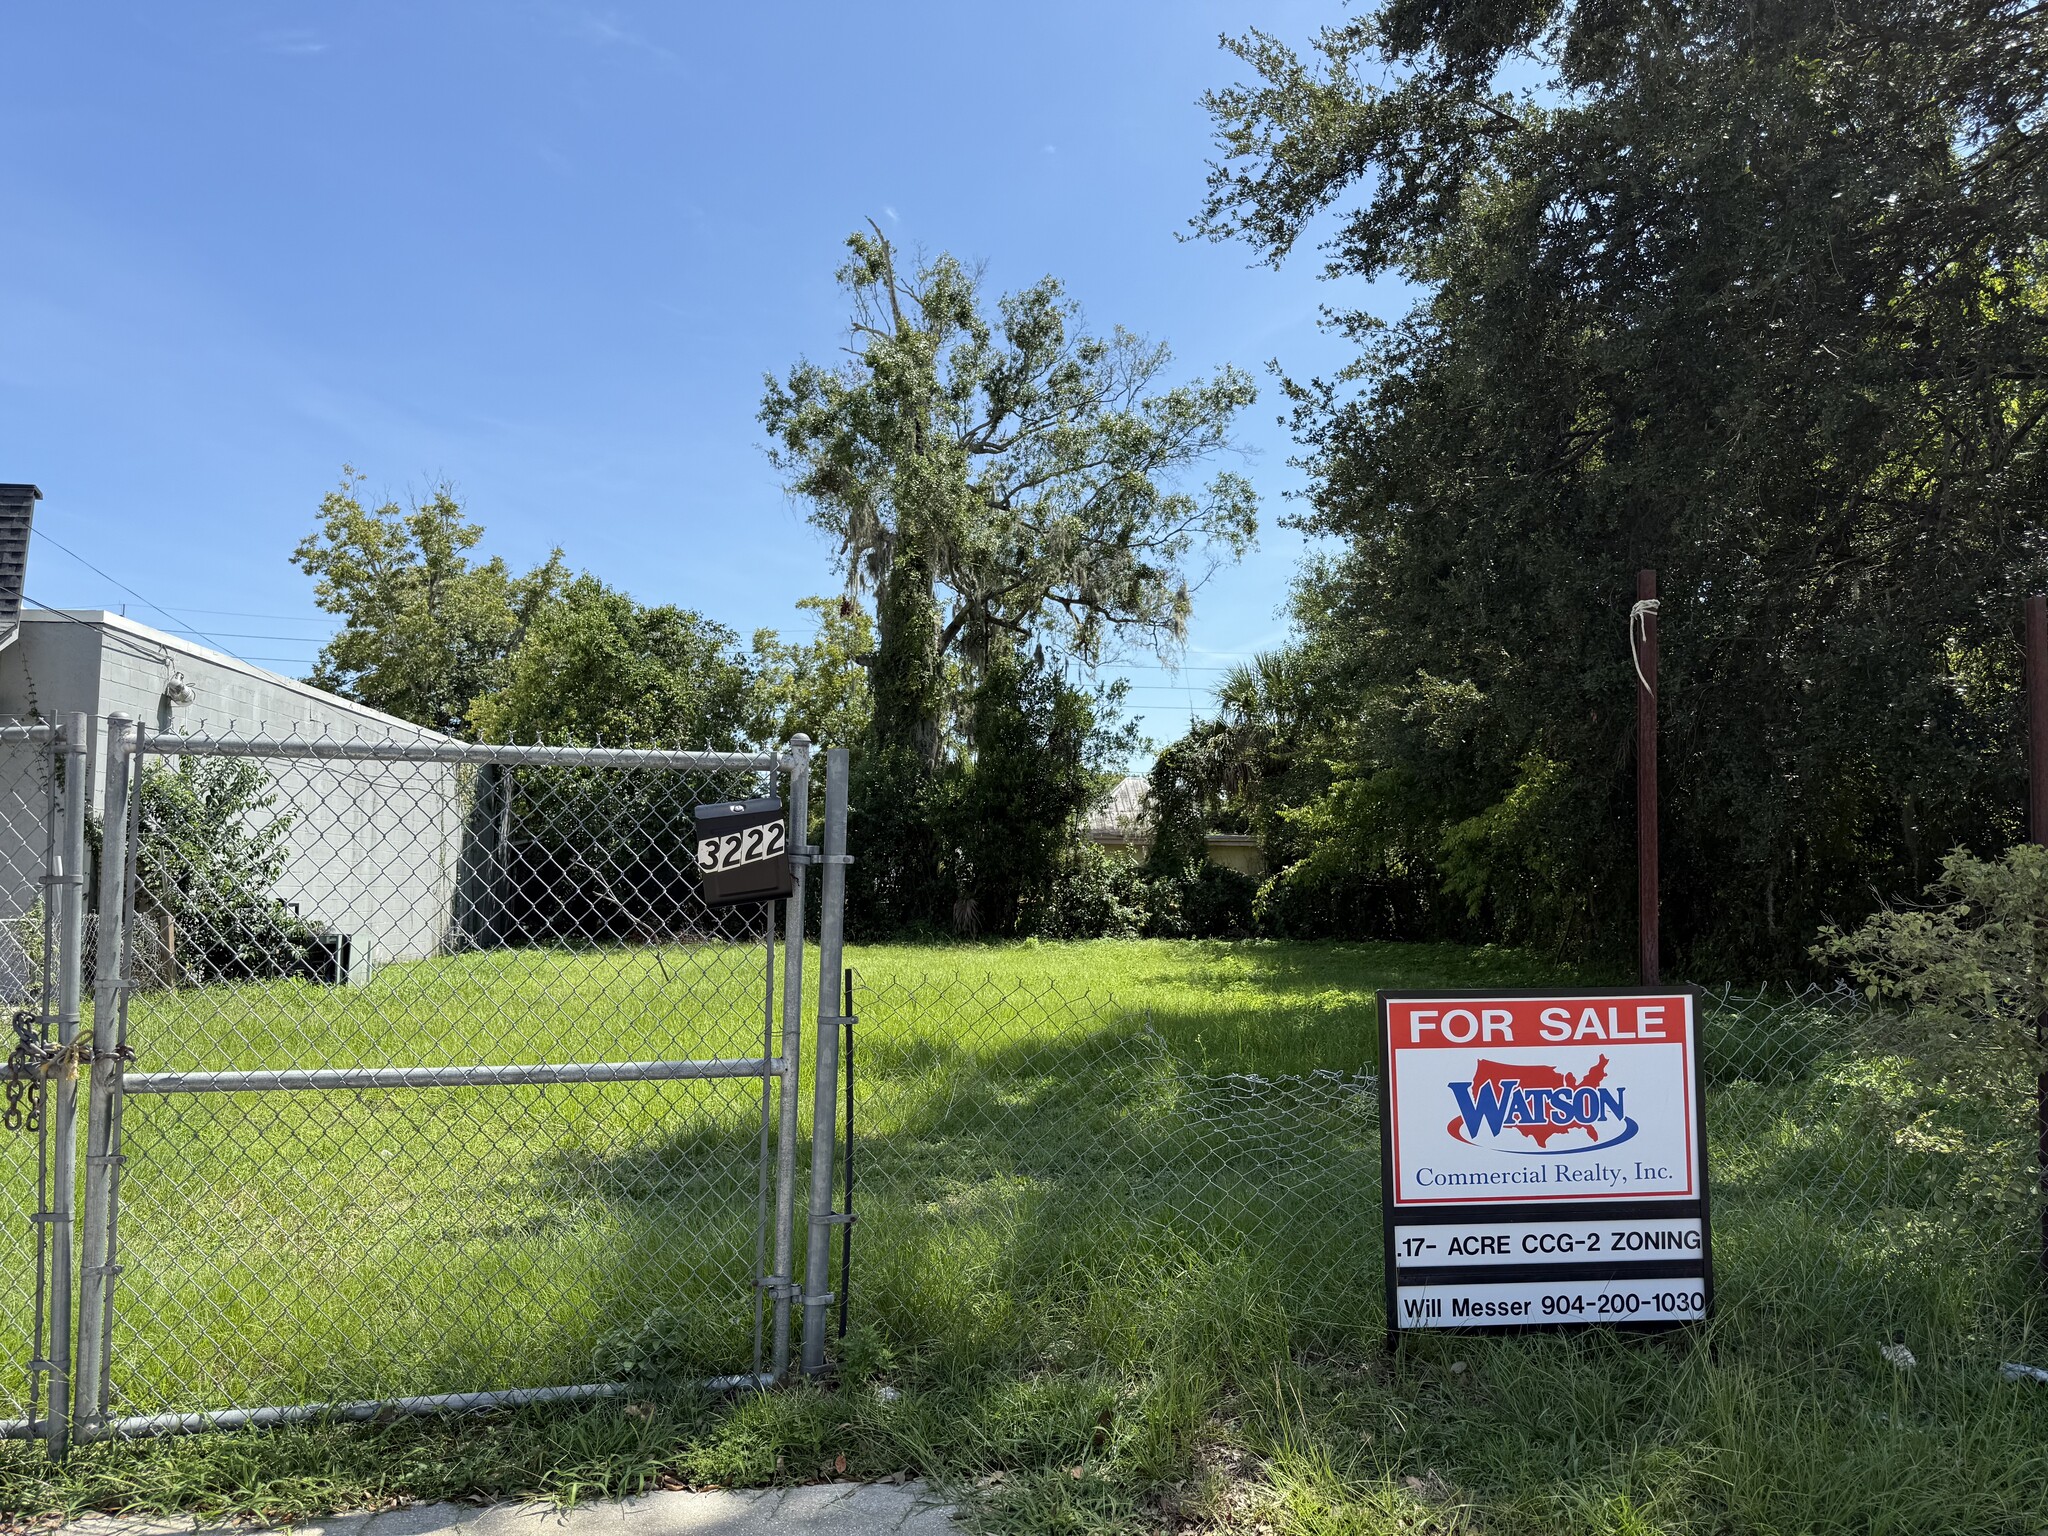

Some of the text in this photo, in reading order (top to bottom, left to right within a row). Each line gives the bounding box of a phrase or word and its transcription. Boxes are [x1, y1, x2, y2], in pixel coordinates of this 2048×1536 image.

[700, 822, 784, 870] 3222
[1409, 1006, 1667, 1043] FOR SALE
[1447, 1079, 1626, 1139] WATSON
[1415, 1162, 1673, 1188] Commercial Realty, Inc.
[1397, 1230, 1701, 1257] .17- ACRE CCG-2 ZONING
[1403, 1292, 1705, 1319] Will Messer 904-200-1030
